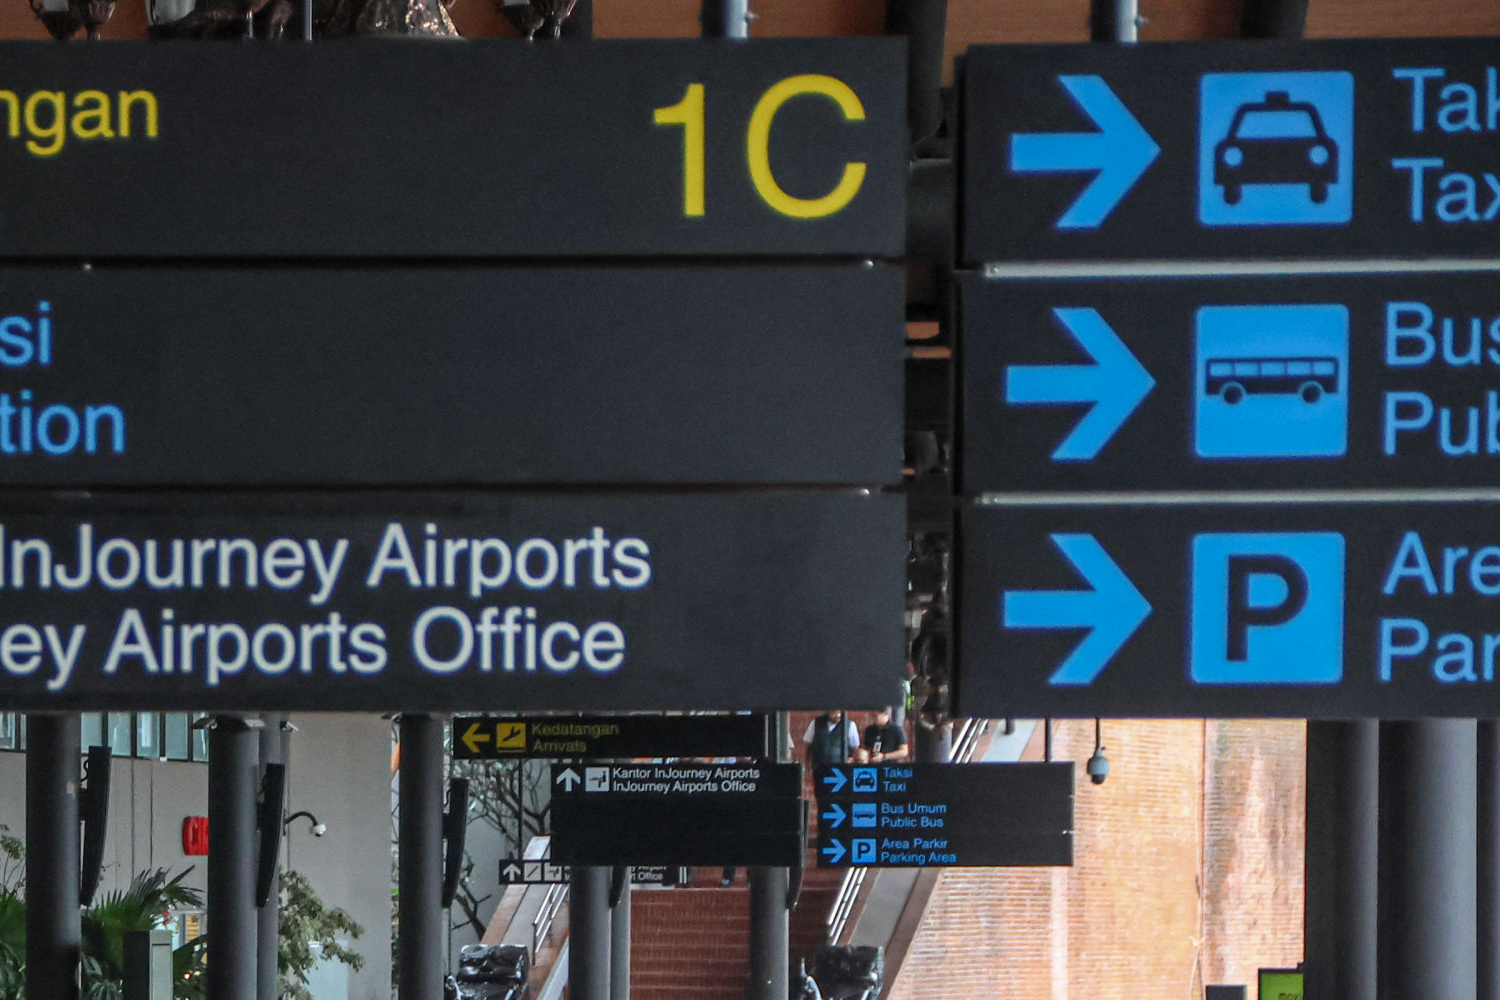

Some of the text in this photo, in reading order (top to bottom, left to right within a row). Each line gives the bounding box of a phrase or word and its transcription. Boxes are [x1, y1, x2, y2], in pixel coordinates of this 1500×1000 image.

[653, 73, 867, 218] 1C
[365, 522, 653, 599] Airports
[1382, 530, 1500, 596] Are
[103, 608, 388, 687] Airports
[411, 605, 626, 674] Office
[531, 723, 619, 738] Kedatangan
[532, 740, 587, 752] Arrivals
[612, 767, 760, 780] Kantor InJourney Airports
[883, 766, 914, 778] Taksi
[612, 780, 757, 794] InJourney Airports Office
[883, 781, 907, 792] Taxi
[881, 803, 947, 814] Bus Umum
[881, 816, 944, 828] Public Bus
[881, 838, 949, 849] Area Parkir
[881, 851, 957, 865] Parking Area
